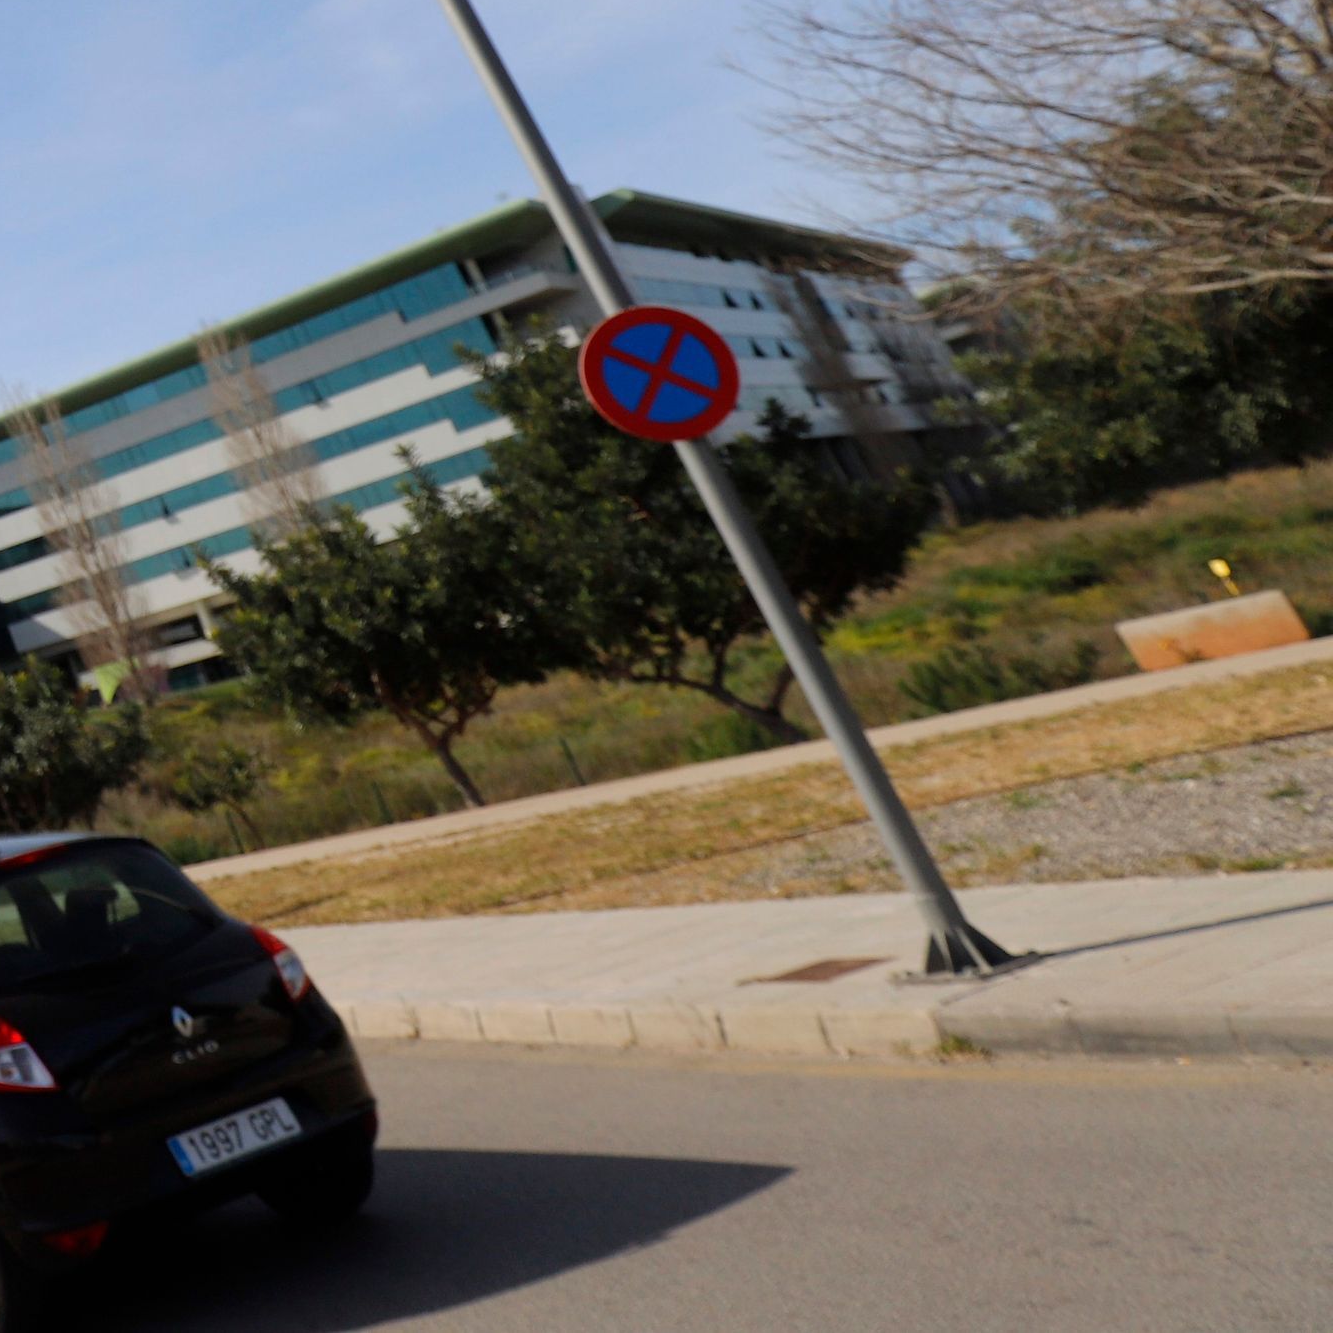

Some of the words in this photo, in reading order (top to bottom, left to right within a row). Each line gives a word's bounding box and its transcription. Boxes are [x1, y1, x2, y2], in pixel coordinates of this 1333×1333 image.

[172, 1039, 219, 1064] CLIO
[187, 1119, 244, 1163] 1997
[248, 1106, 295, 1141] GPL
